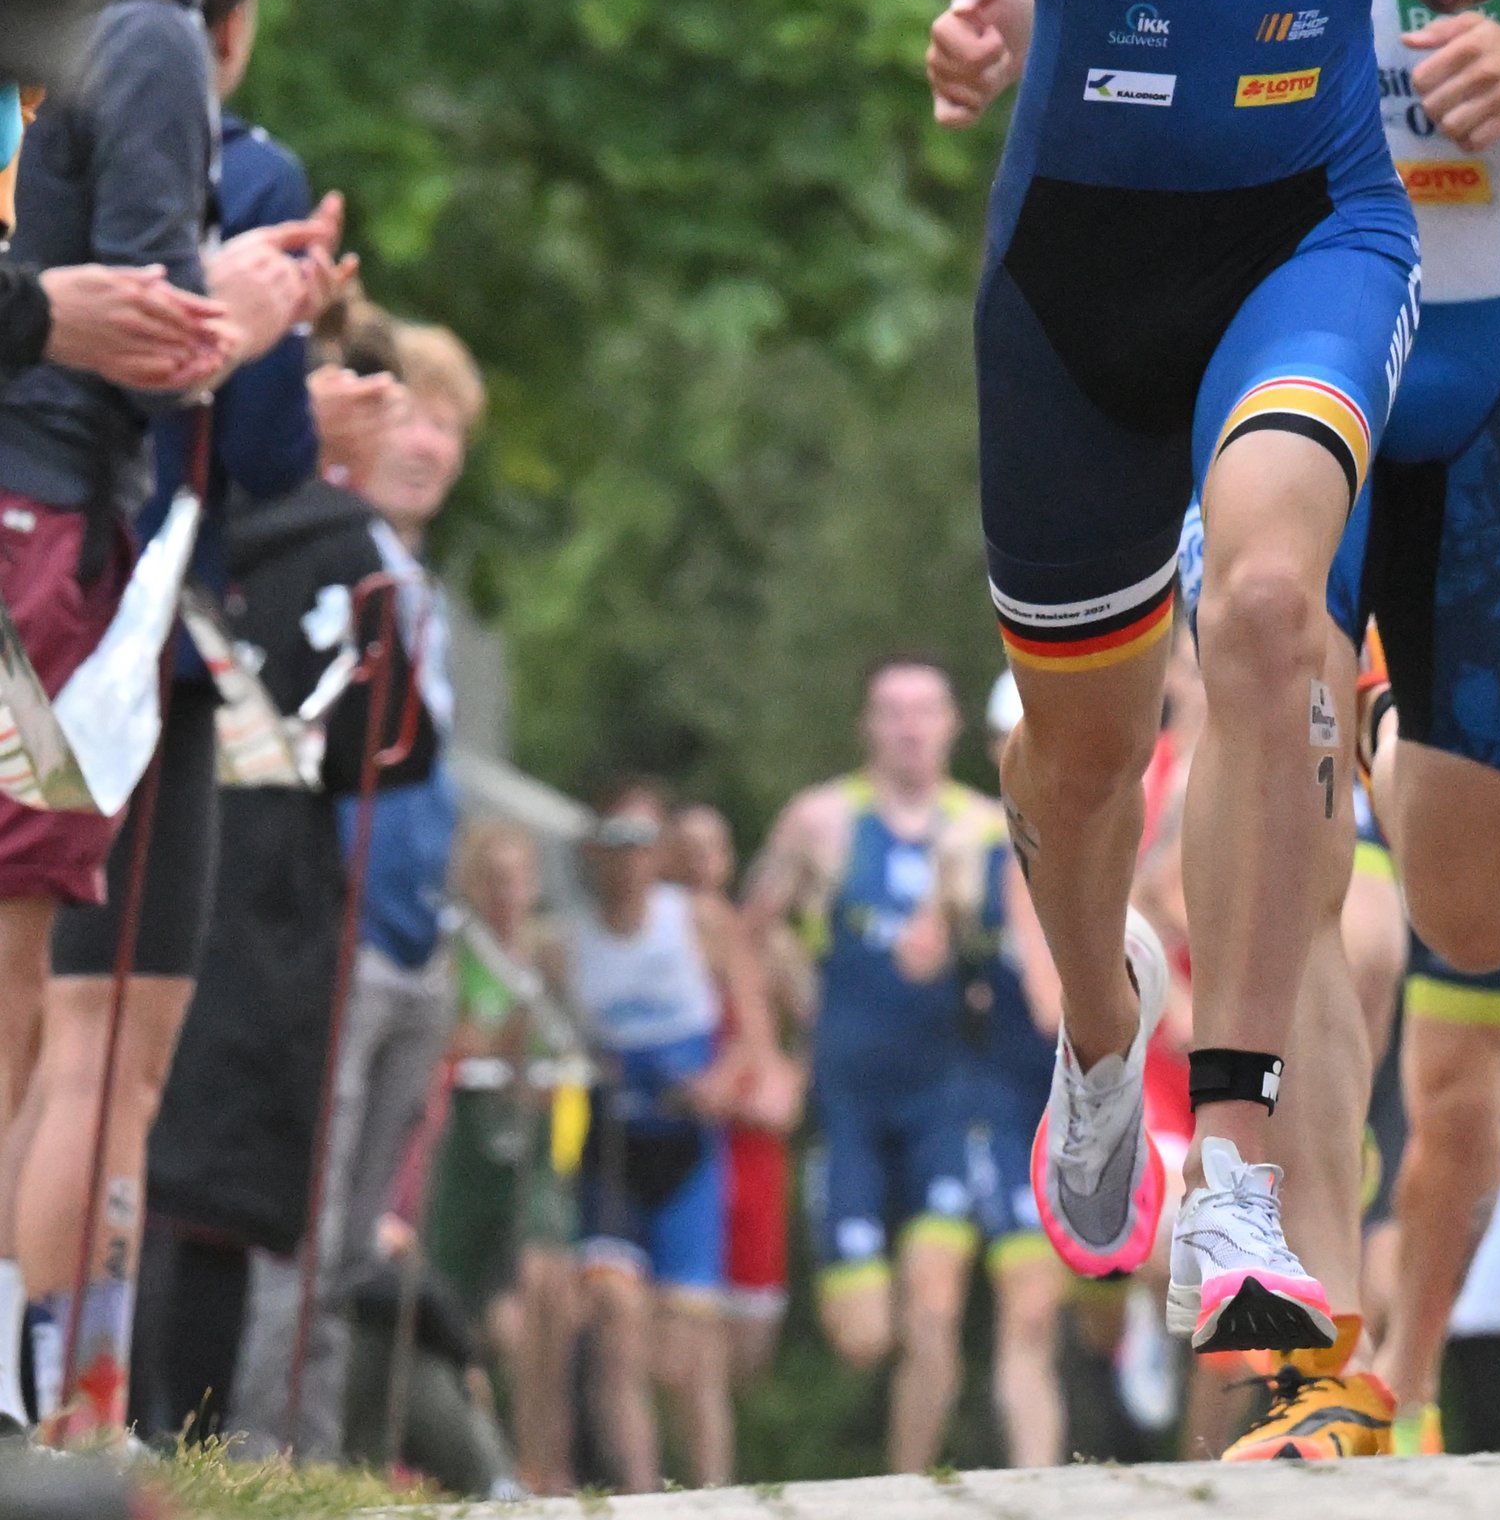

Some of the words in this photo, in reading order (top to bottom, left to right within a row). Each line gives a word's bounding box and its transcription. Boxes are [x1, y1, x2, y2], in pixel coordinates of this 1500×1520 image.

[1297, 9, 1320, 20] TRI
[1292, 16, 1329, 31] SHOP
[1107, 31, 1169, 49] Südwest
[1266, 75, 1315, 94] LOTTO
[1117, 89, 1168, 102] KALODION
[1317, 755, 1334, 819] 1
